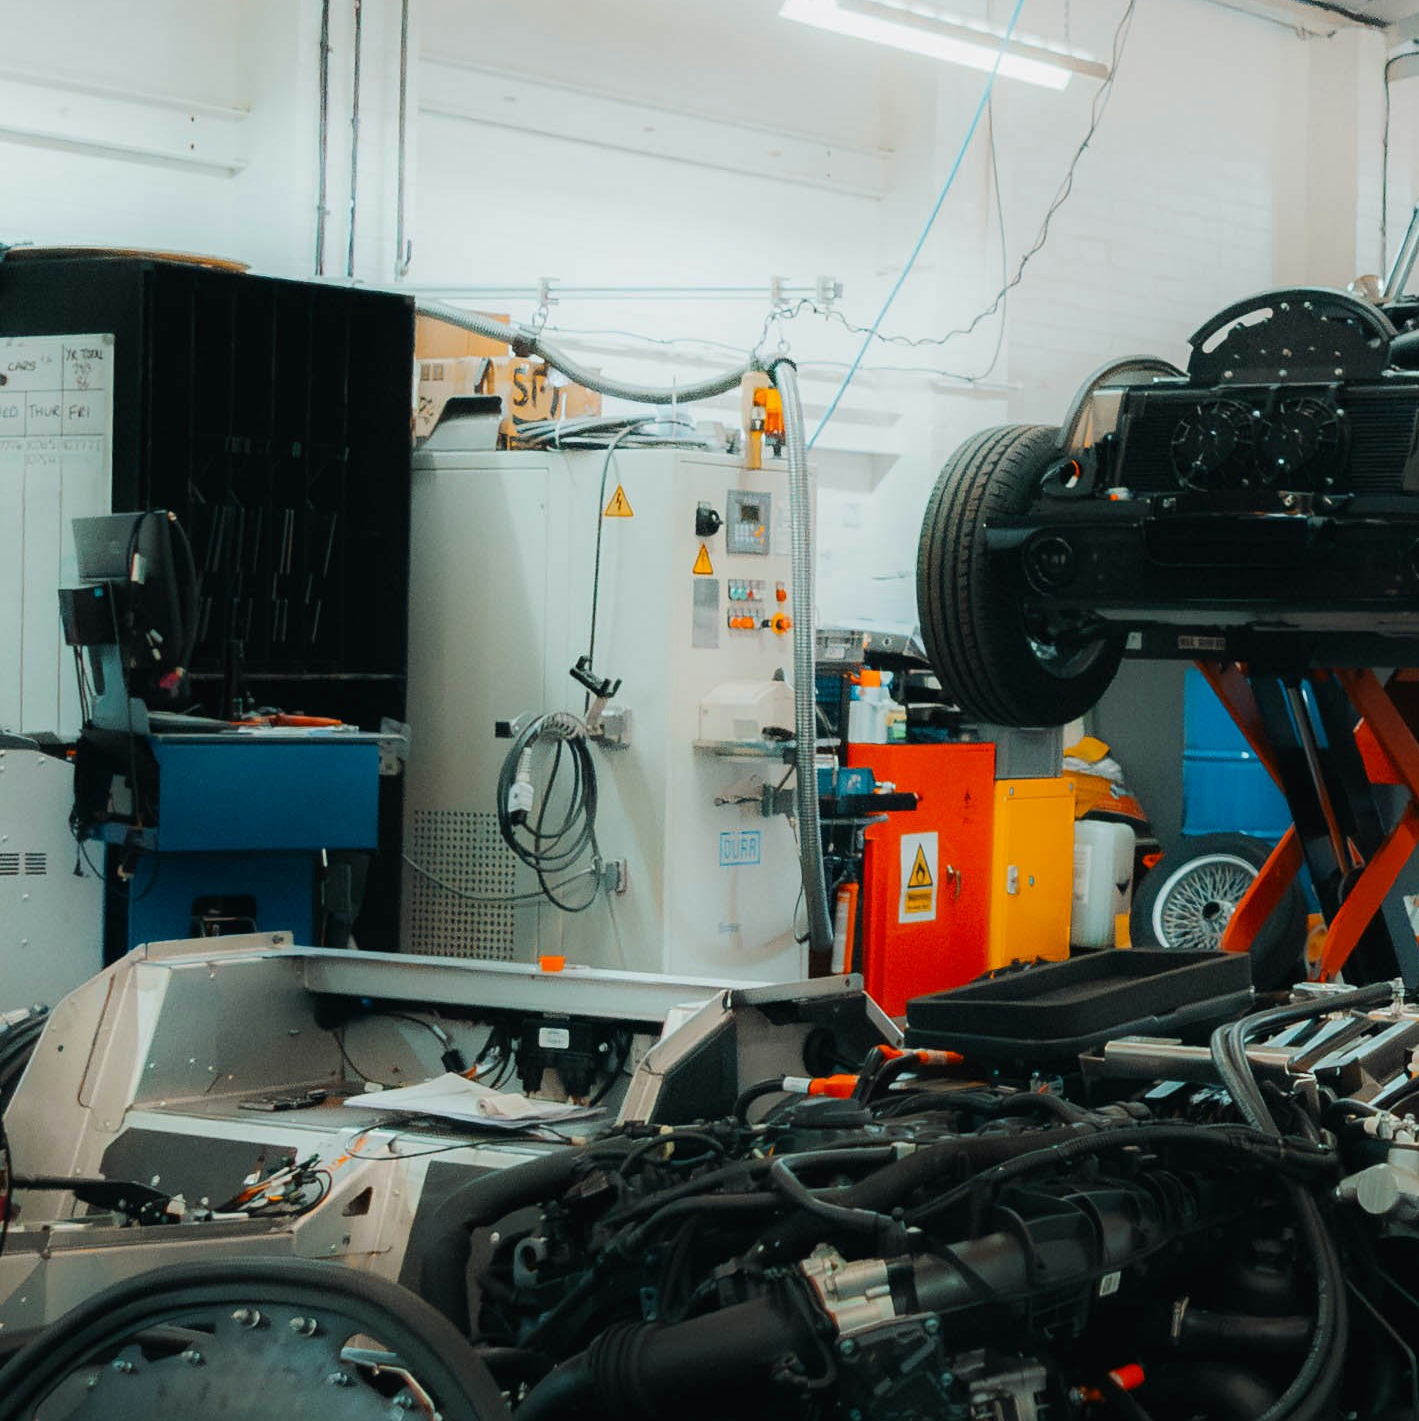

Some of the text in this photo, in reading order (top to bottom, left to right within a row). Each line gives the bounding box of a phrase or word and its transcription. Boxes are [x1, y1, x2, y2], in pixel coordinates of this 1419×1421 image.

[0, 406, 18, 418] ED
[29, 404, 61, 419] THUR
[68, 404, 90, 419] FRI
